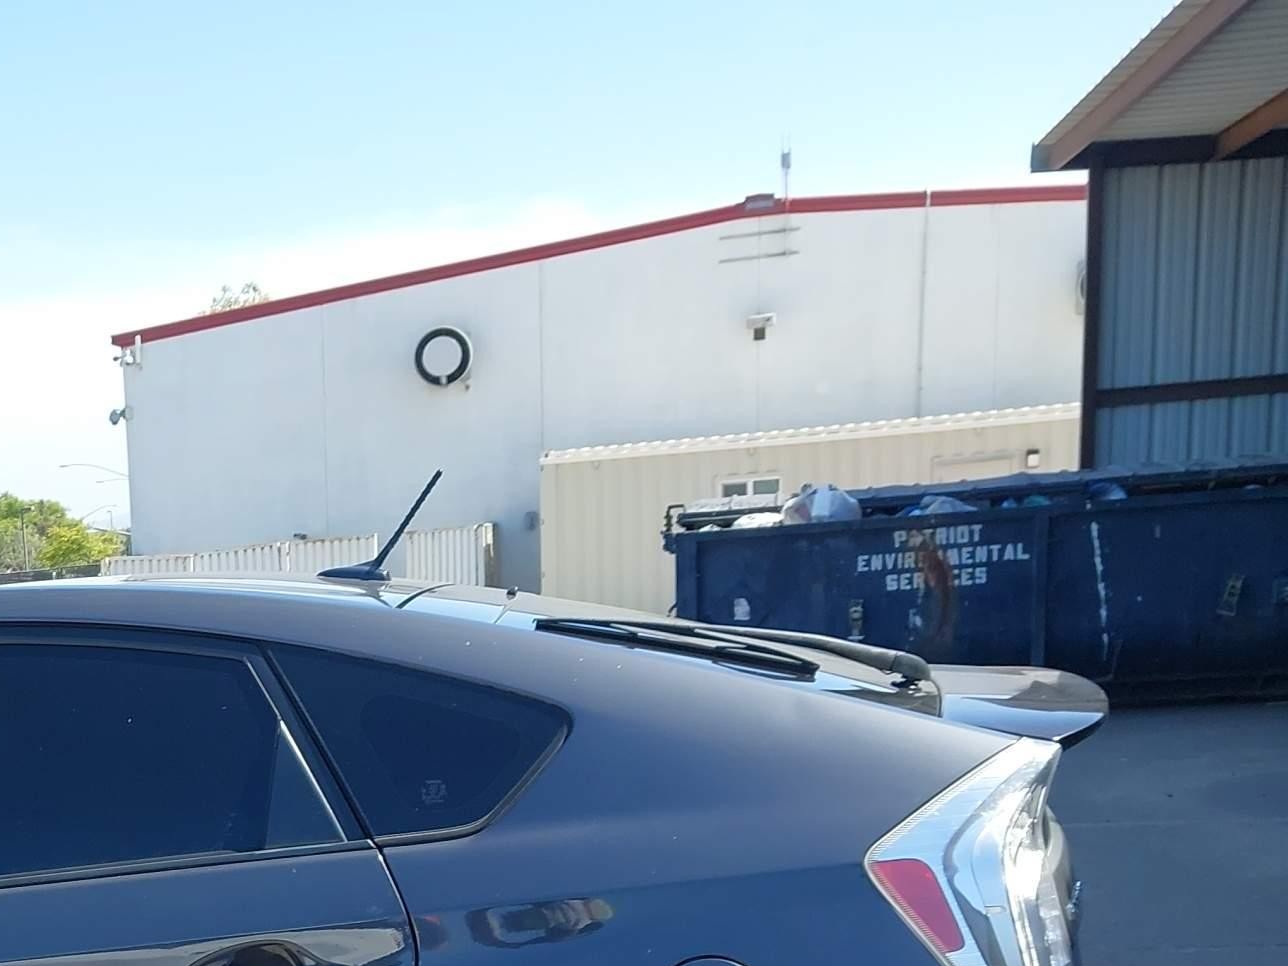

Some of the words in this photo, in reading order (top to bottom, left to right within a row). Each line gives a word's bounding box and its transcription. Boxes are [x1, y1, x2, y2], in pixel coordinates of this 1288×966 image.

[893, 524, 984, 548] PATRIOT
[857, 542, 1030, 572] ENVIRMENTAL
[885, 566, 988, 591] SERCES
